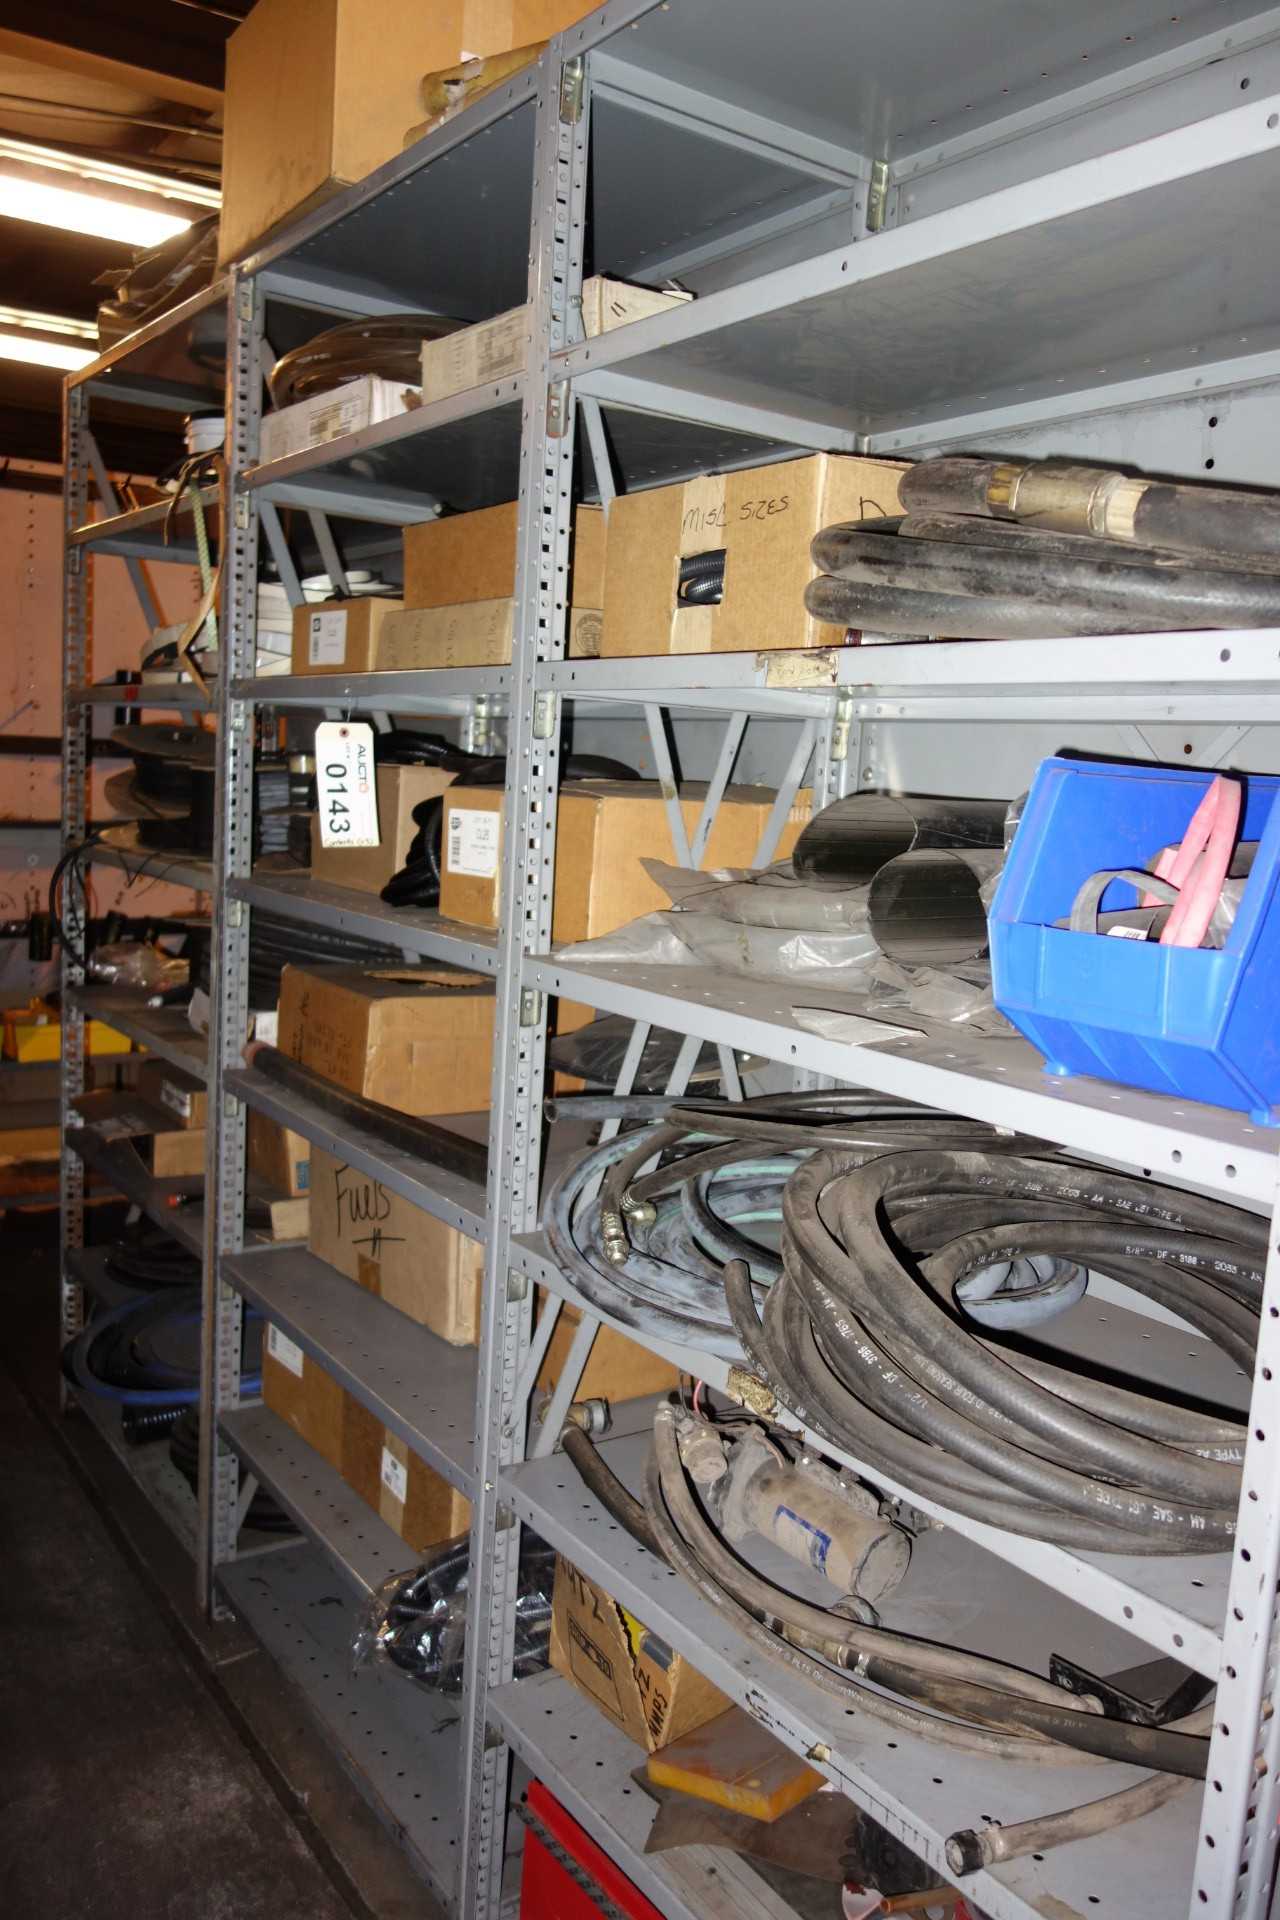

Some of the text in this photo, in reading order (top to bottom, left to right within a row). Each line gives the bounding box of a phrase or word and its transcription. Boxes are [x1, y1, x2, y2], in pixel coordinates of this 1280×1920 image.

[740, 495, 789, 520] SIZES
[325, 763, 351, 834] 0143
[1157, 1250, 1168, 1259] DF
[881, 1371, 899, 1384] DF
[1215, 1447, 1243, 1461] TYPE
[1152, 1505, 1174, 1523] SAE
